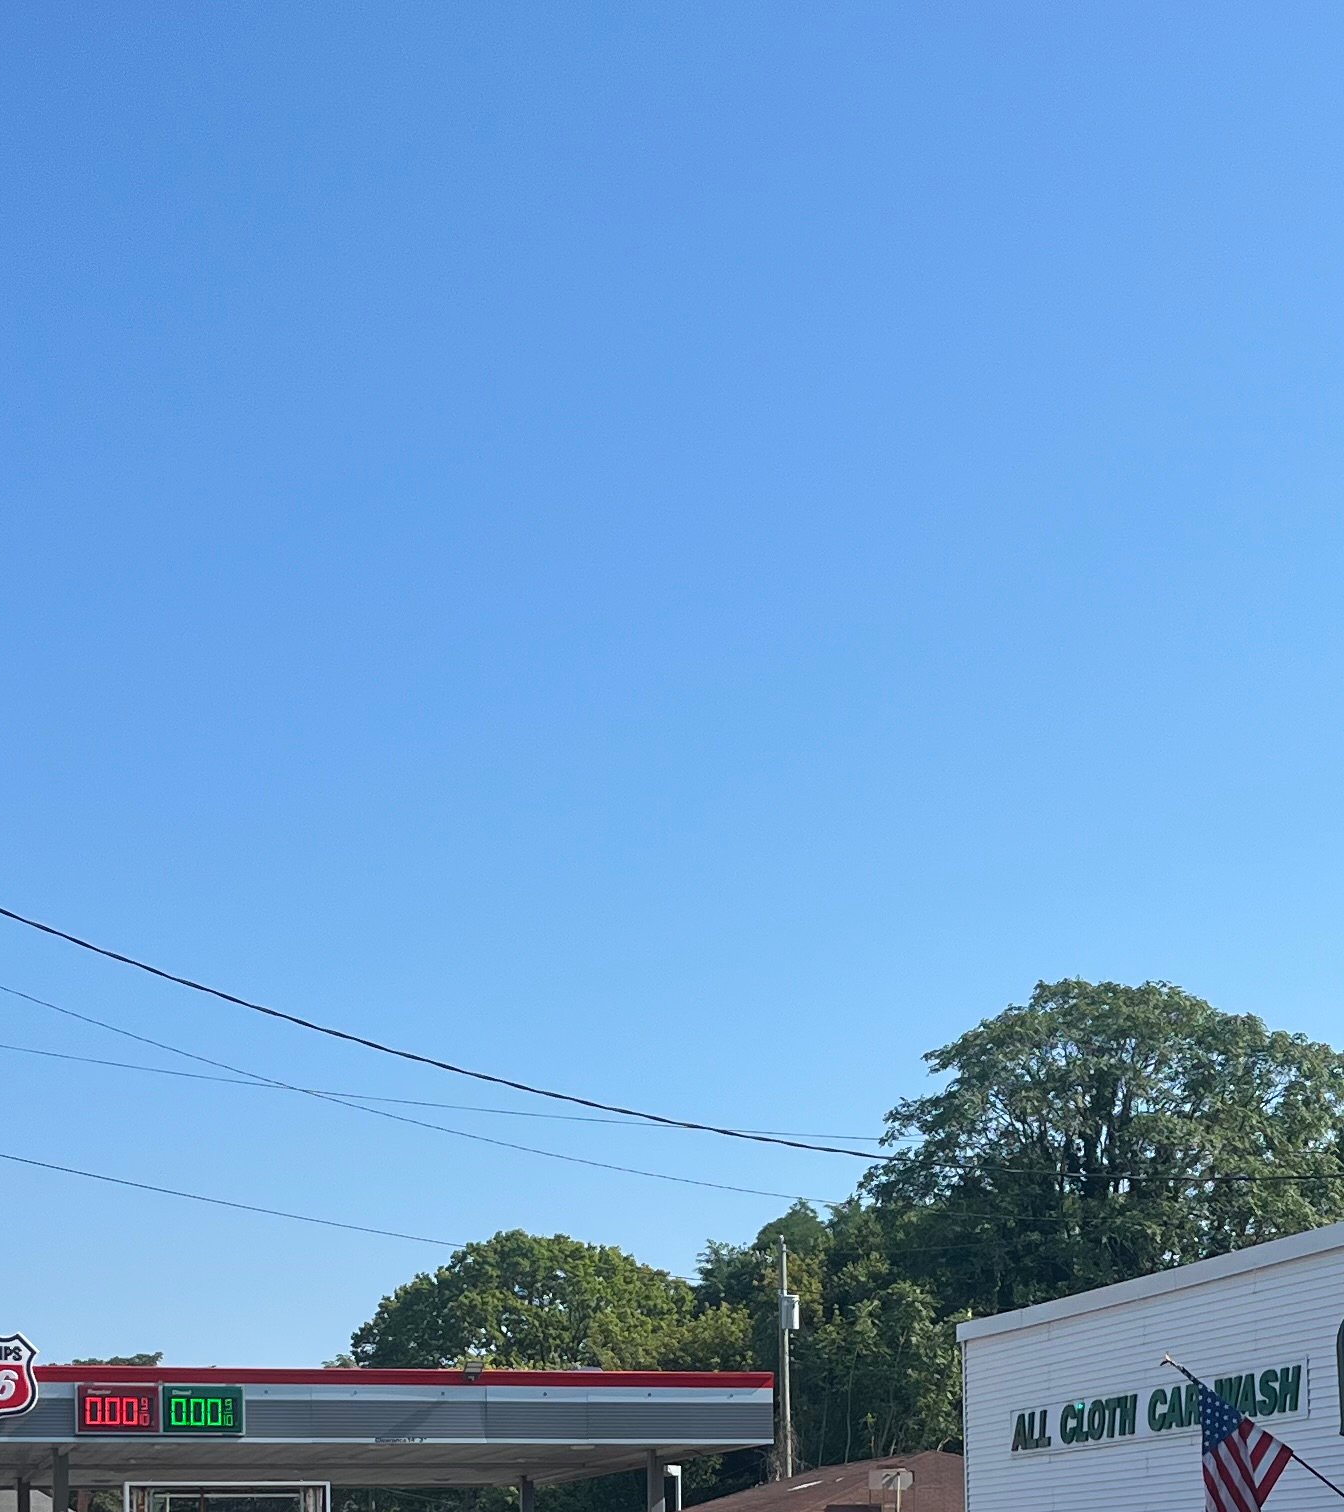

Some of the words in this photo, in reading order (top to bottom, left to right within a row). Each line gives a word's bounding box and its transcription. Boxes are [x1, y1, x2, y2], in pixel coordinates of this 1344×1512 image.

[1011, 1409, 1051, 1451] ALL
[1060, 1394, 1138, 1444] CLOTH
[1148, 1383, 1202, 1431] CAR
[1214, 1364, 1301, 1417] WASH
